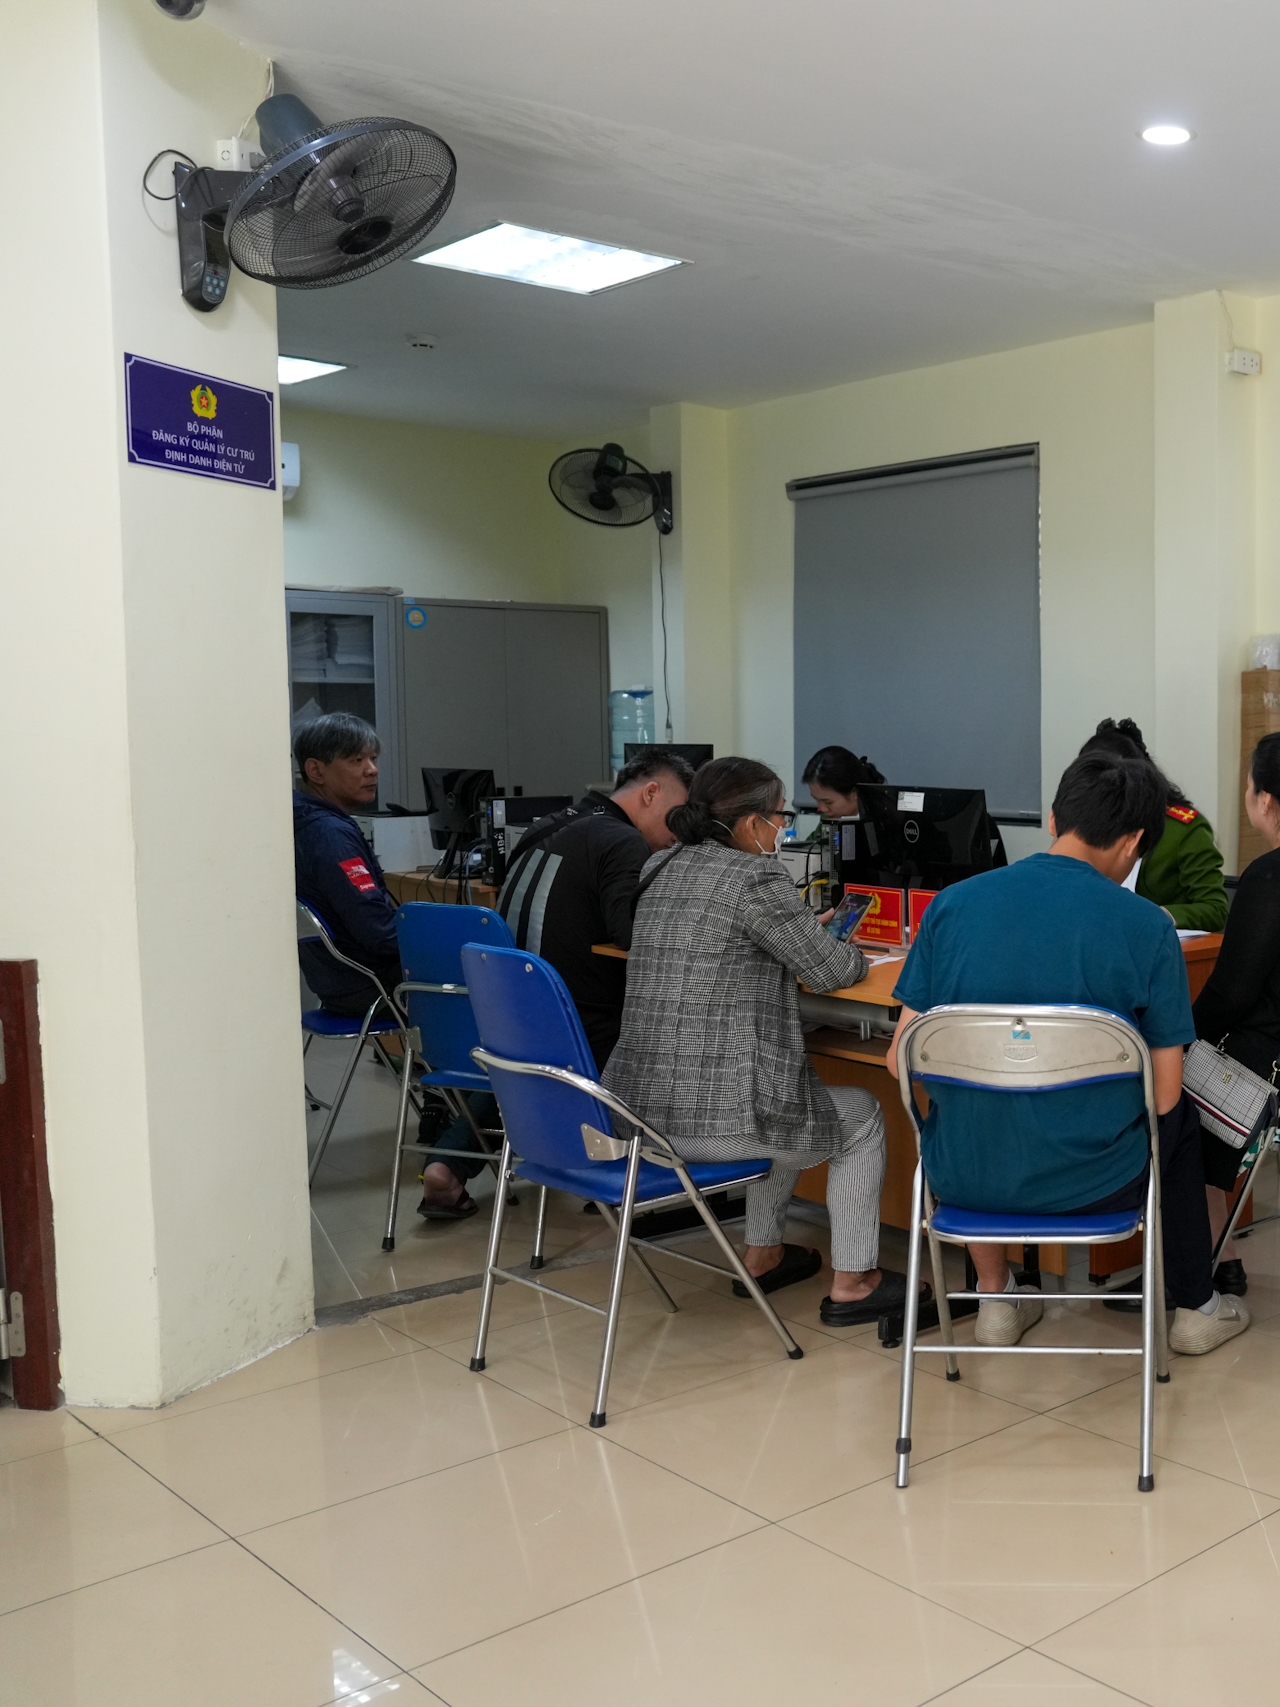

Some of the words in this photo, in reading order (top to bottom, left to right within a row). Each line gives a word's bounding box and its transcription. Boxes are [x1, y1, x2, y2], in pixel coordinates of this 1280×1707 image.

[187, 422, 199, 435] BỘ
[201, 425, 223, 438] PHẬN
[152, 430, 177, 444] ĐĂNG
[179, 435, 190, 446] KÝ
[191, 439, 215, 452] QUẢN
[217, 443, 225, 454] LÝ
[226, 447, 238, 457] CƯ
[239, 449, 255, 461] TRÚ
[165, 449, 187, 462] ĐỊNH
[188, 454, 212, 467] DANH
[213, 459, 232, 472] ĐIỆN
[233, 461, 245, 474] TỬ
[906, 828, 918, 836] DELL
